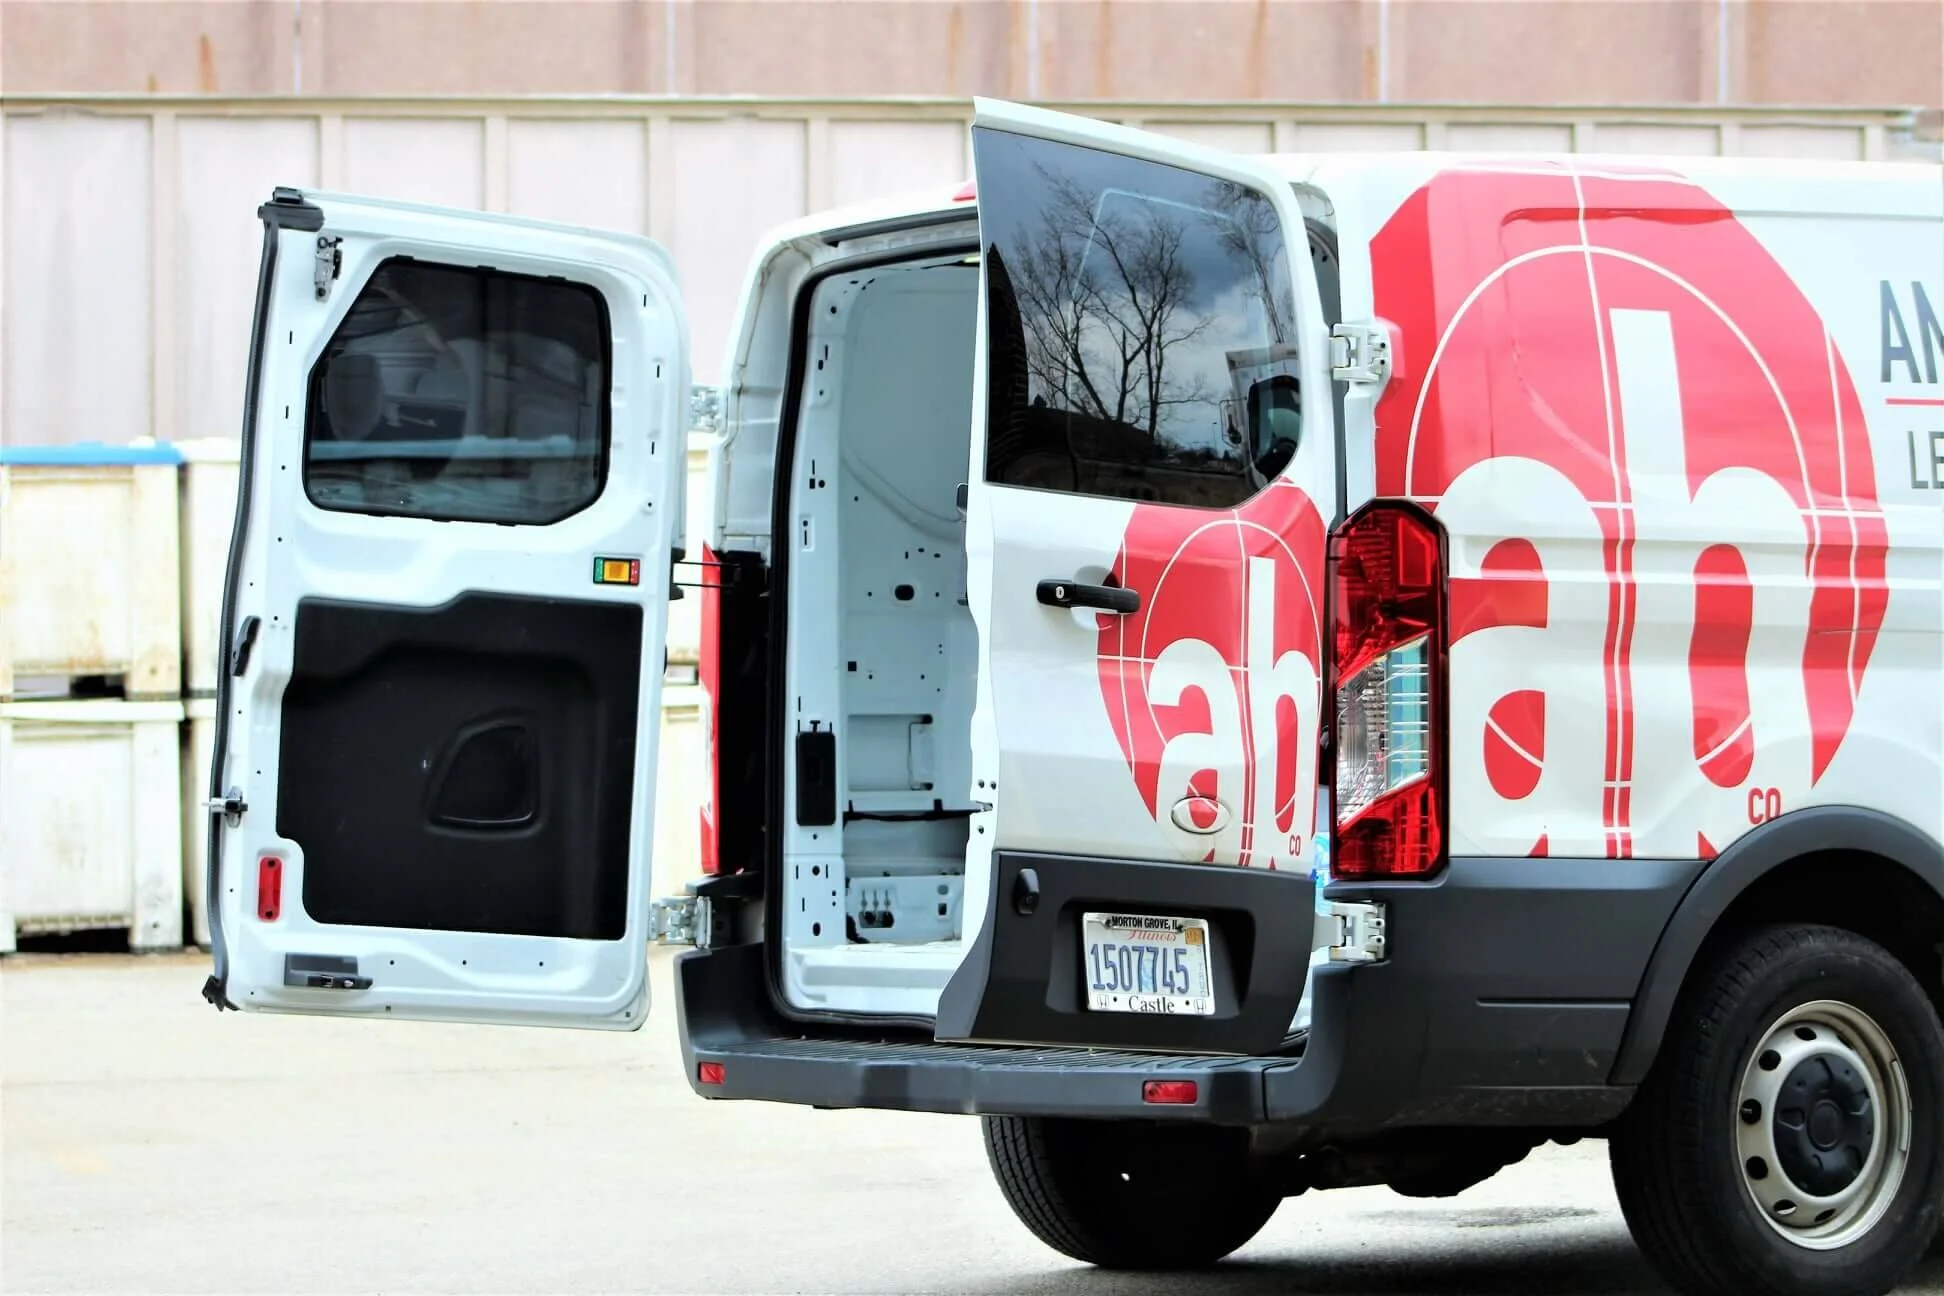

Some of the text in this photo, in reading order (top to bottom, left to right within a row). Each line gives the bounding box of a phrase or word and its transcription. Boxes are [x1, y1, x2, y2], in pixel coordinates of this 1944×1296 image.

[1748, 787, 1782, 825] CO
[1289, 834, 1301, 857] CO
[1111, 916, 1142, 928] MORTON
[1144, 918, 1171, 930] GROVE,
[1090, 944, 1189, 995] 1507745
[1128, 995, 1175, 1014] Castle
